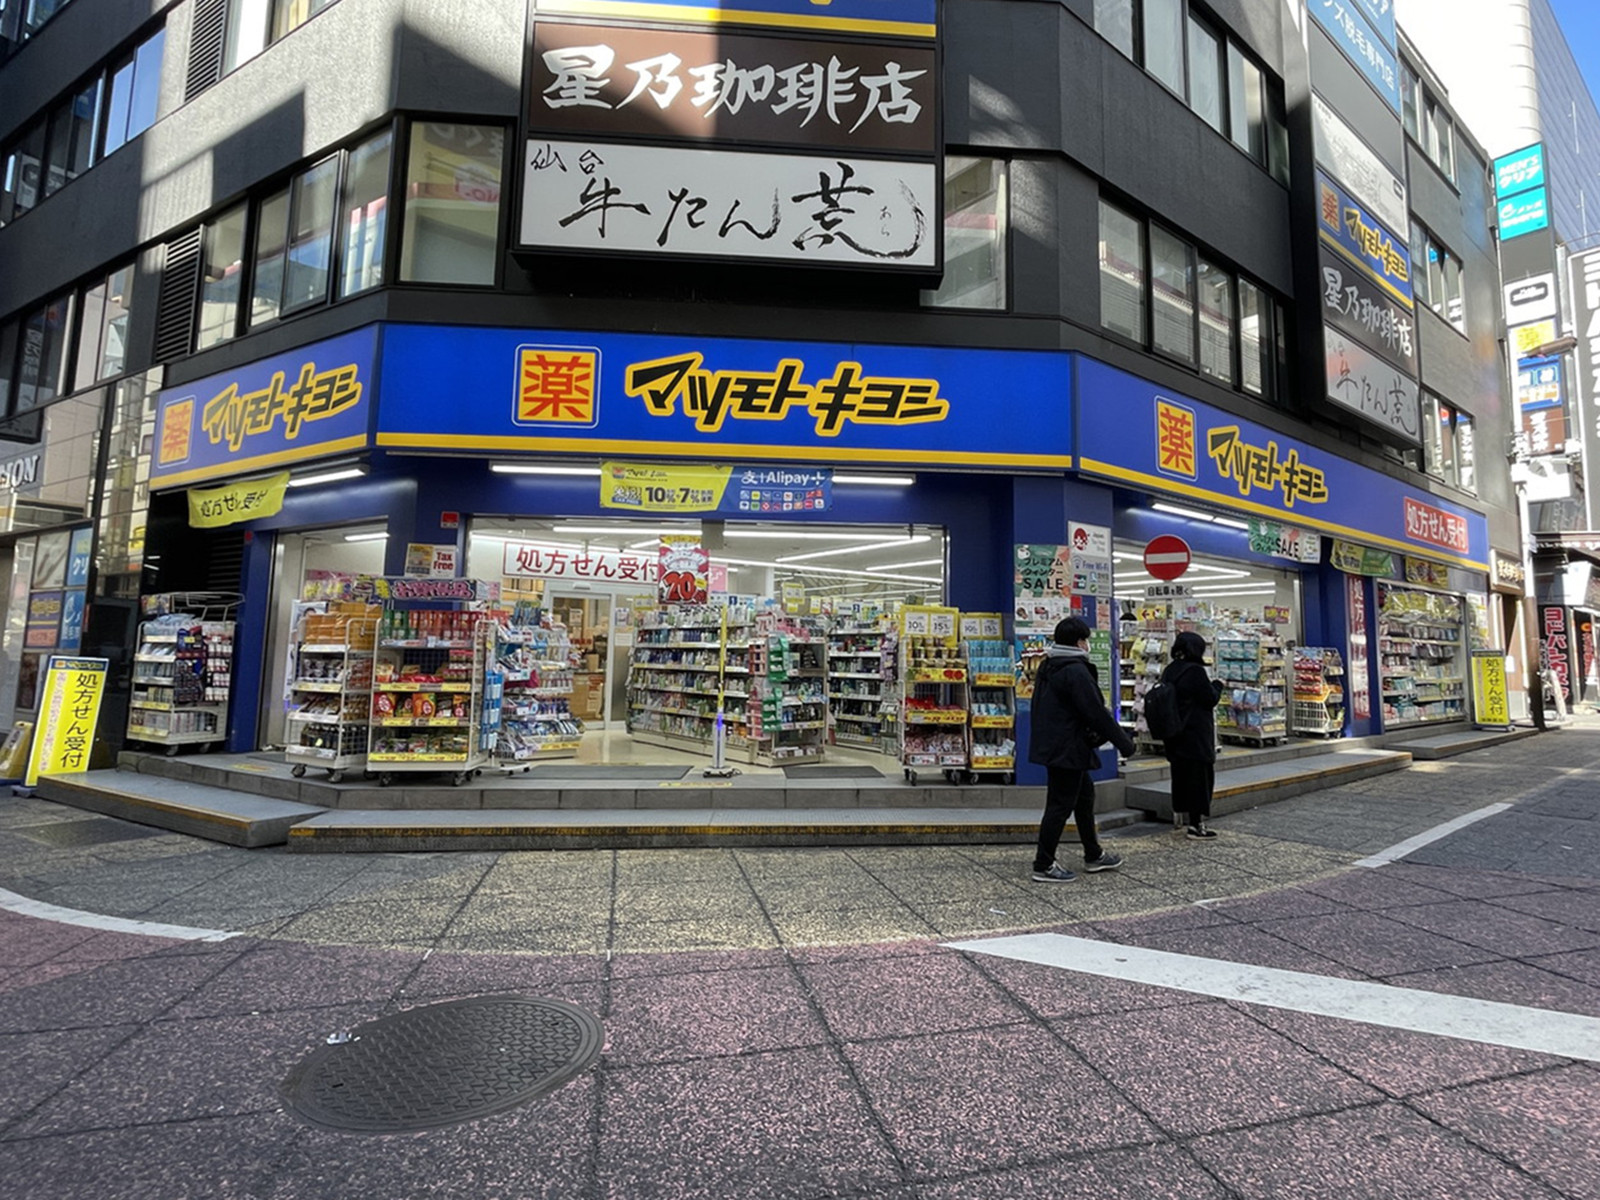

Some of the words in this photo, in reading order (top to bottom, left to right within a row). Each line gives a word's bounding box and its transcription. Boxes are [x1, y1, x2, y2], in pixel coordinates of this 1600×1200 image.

[541, 44, 928, 134] 星乃珈琲店
[530, 143, 605, 176] 仙台
[1344, 207, 1408, 283] マツモトキヨシ
[1323, 266, 1412, 358] 星乃珈琲店
[163, 404, 192, 462] 薬
[202, 362, 363, 452] マツモトキヨシ
[523, 352, 593, 420] 薬
[626, 352, 949, 438] マツモトキヨシ
[1159, 407, 1193, 473] 薬
[1207, 425, 1329, 508] マツモトキヨシ
[1275, 537, 1300, 559] SALE
[1407, 501, 1467, 549] 処方せん受付
[433, 561, 454, 570] Free
[436, 552, 452, 561] Tax
[516, 546, 657, 582] 処方せん受付
[1024, 558, 1063, 566] プレミアム
[1023, 578, 1063, 590] SALE
[1486, 658, 1503, 716] 処方せん受付
[60, 672, 98, 769] 処方せん受付
